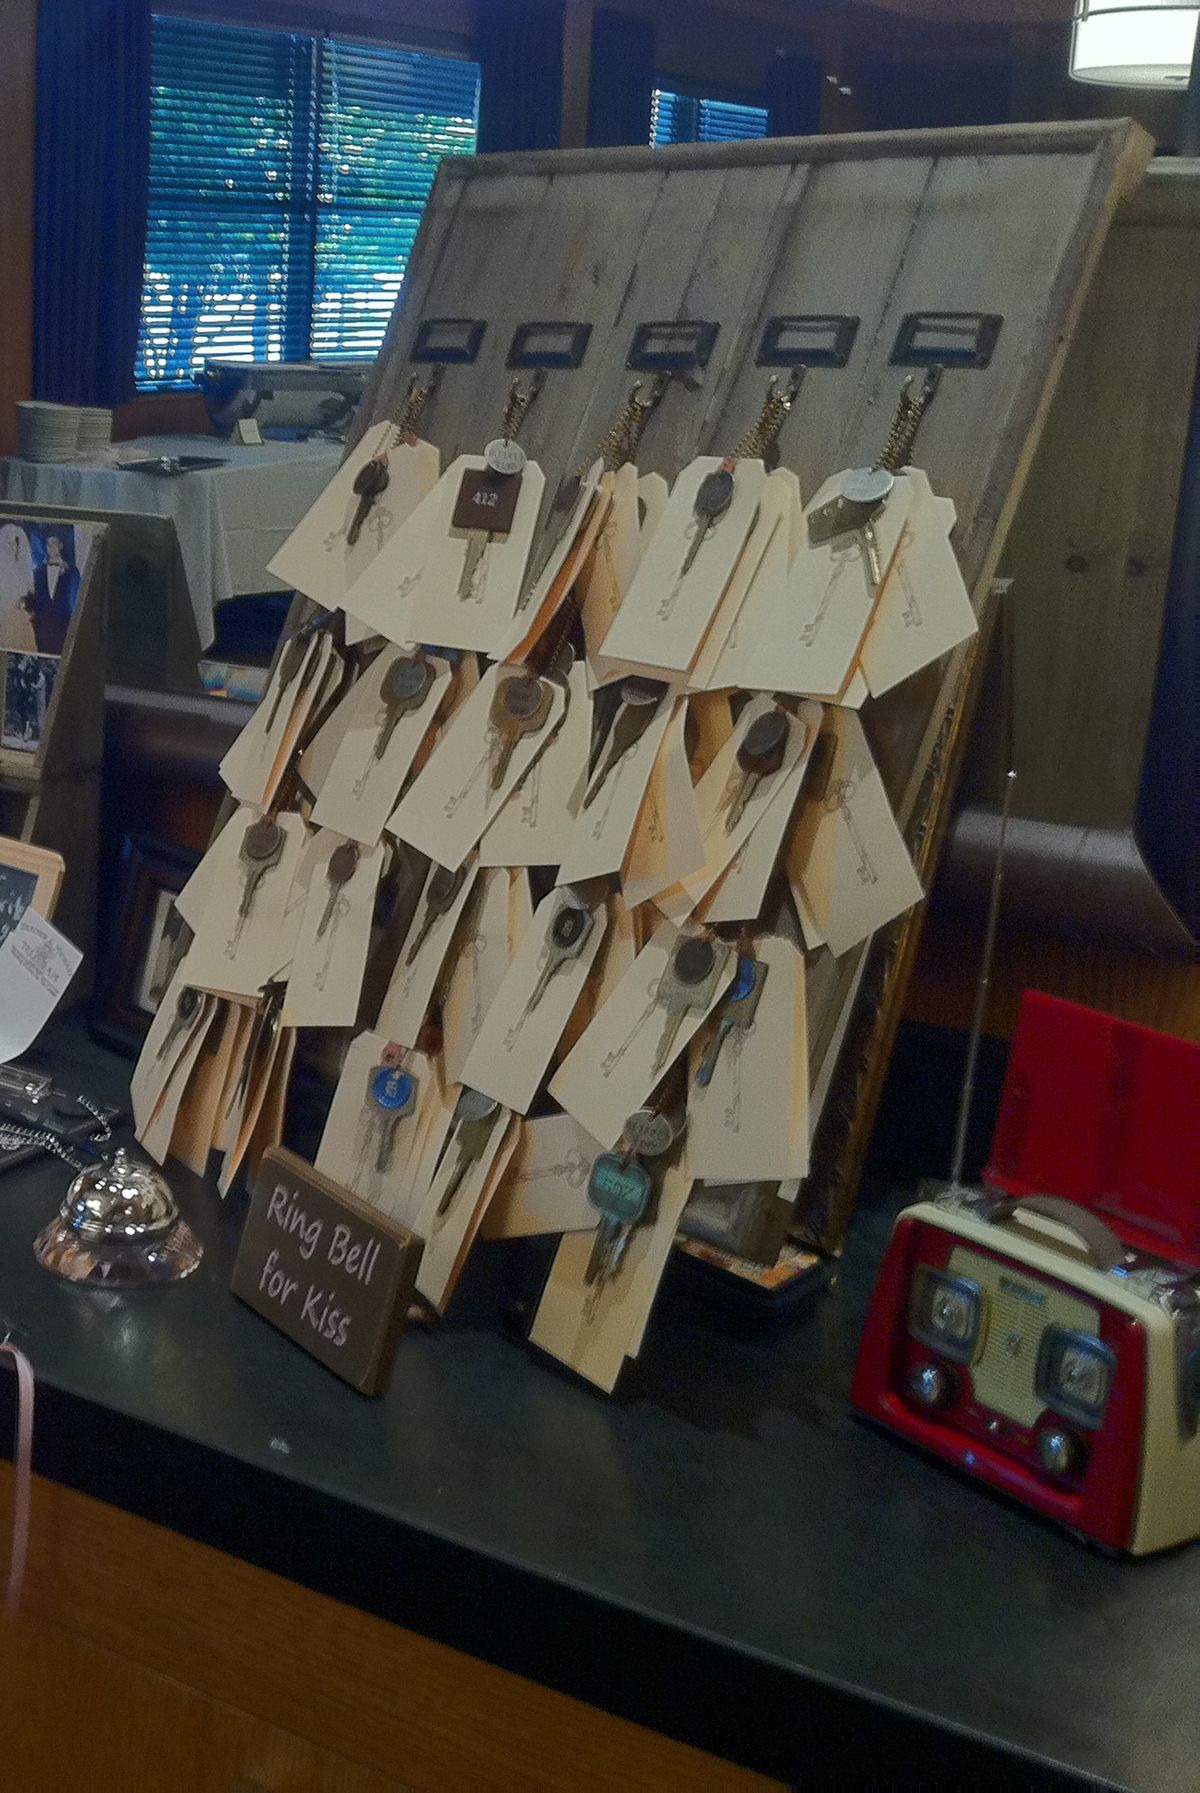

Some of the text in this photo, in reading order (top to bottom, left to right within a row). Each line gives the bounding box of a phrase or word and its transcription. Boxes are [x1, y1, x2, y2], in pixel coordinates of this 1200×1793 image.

[472, 491, 498, 507] 412
[266, 1182, 382, 1286] Ring Bell
[258, 1249, 352, 1346] for Kiss
